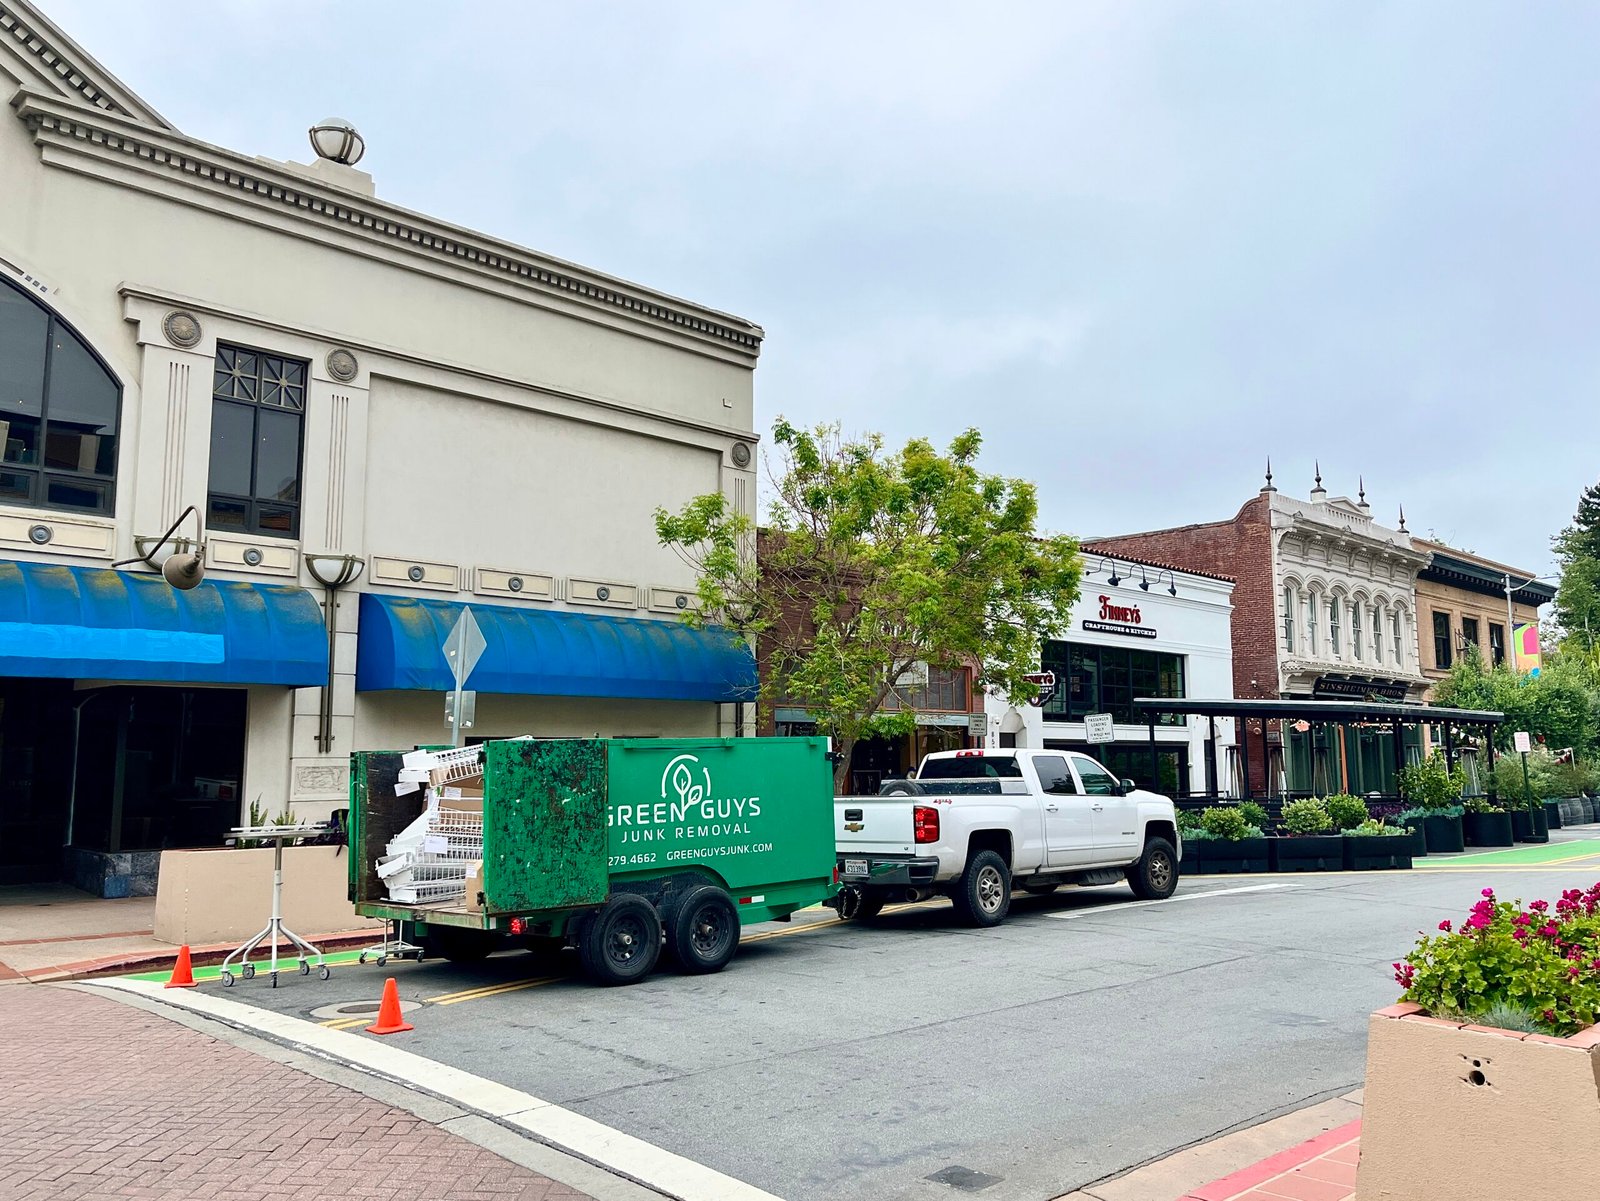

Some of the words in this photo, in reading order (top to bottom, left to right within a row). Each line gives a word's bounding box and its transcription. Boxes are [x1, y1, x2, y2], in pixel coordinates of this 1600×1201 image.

[1084, 622, 1125, 633] CRAFTHOUSE
[1130, 628, 1156, 637] KITCHEN
[1320, 682, 1379, 695] SINSHEIMER
[701, 797, 761, 820] GUYS
[621, 828, 666, 844] JUNK
[675, 822, 751, 840] REMOVAL
[666, 842, 773, 862] GREENGUYSJUNK.COM
